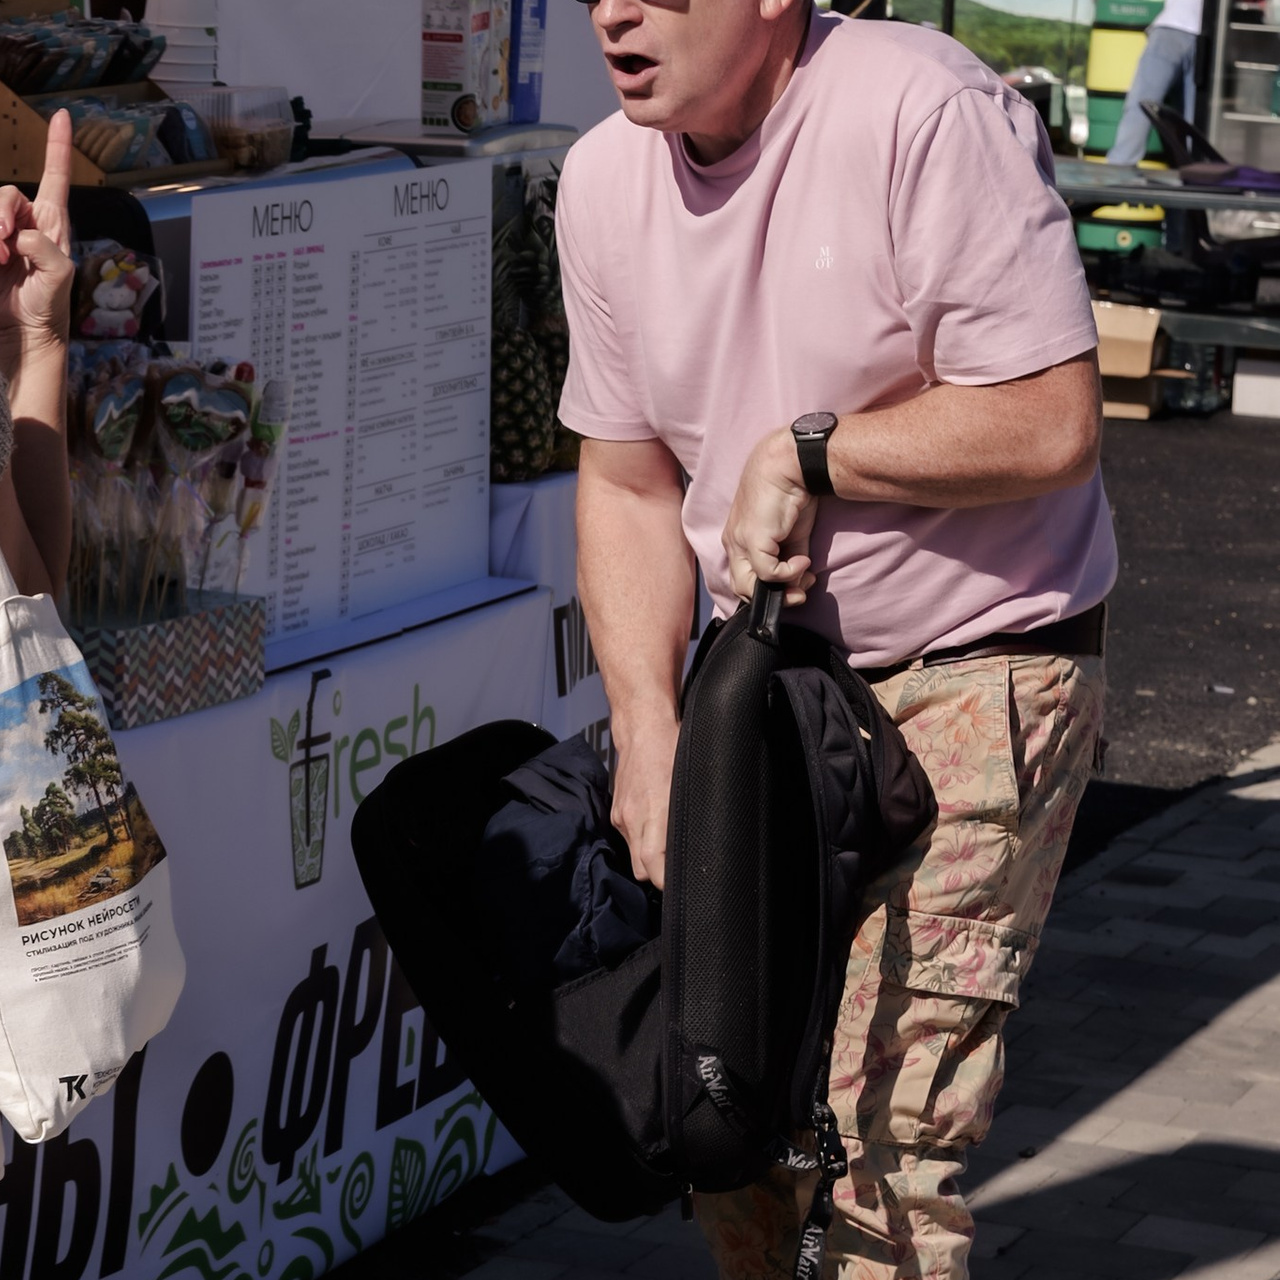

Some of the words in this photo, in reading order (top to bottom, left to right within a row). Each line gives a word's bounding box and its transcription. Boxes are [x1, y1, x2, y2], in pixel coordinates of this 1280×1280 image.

[394, 177, 450, 217] МЕНЮ
[252, 199, 313, 238] МЕНЮ
[21, 920, 85, 946] РИСУНОК
[87, 895, 140, 927] НЕЙРОСЕТИ
[26, 938, 78, 958] СТИЛИЗАЦИЯ
[79, 934, 94, 944] ПОД
